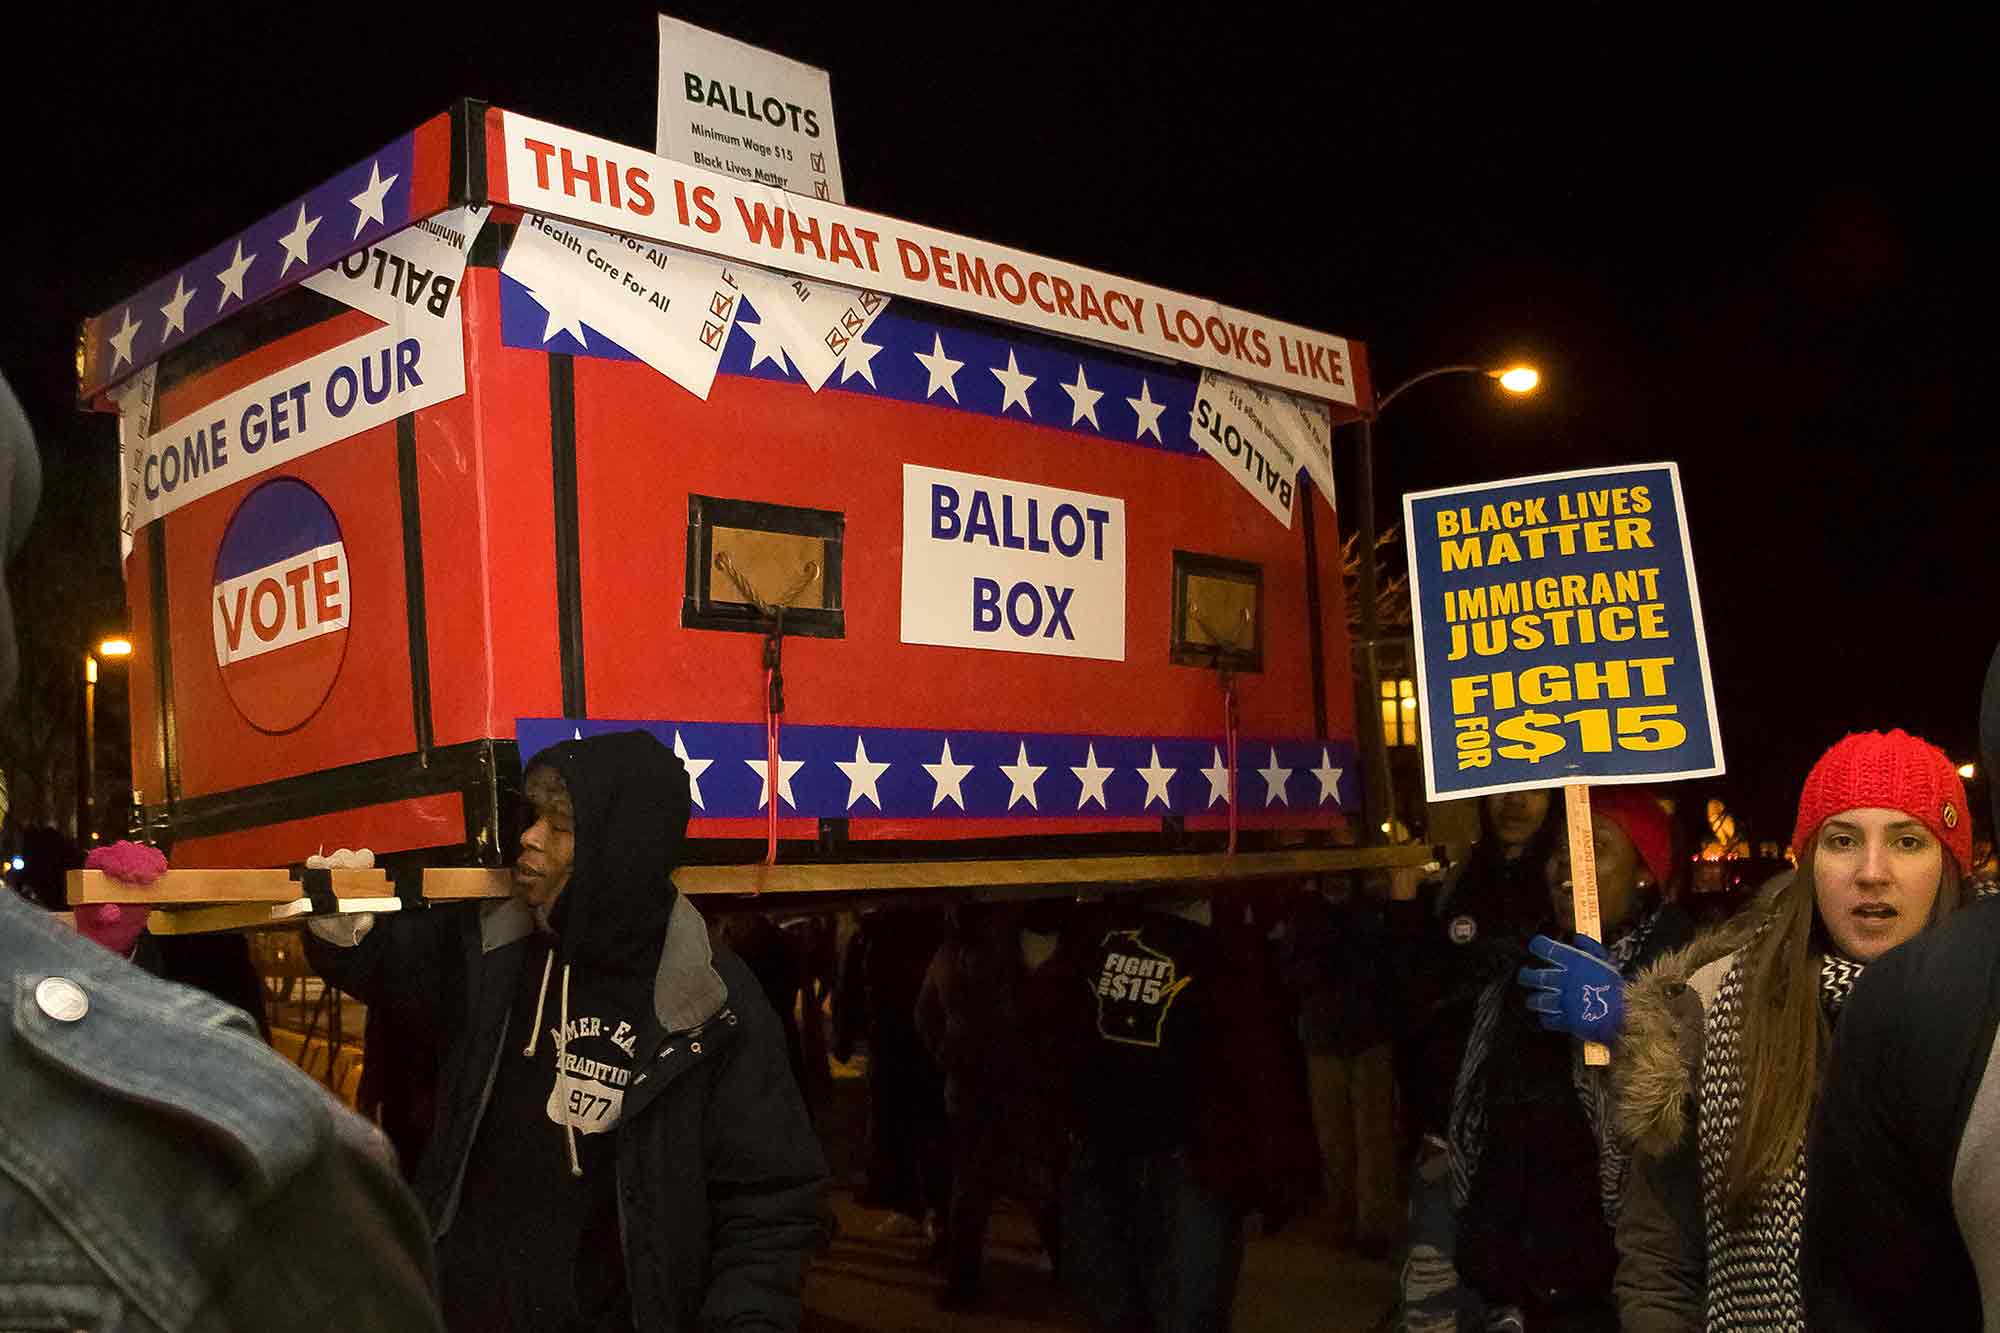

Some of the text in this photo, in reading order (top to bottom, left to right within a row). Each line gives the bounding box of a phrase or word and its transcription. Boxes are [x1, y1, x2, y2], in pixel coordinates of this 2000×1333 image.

[683, 71, 821, 139] BALLOTS
[691, 122, 794, 162] Minimum Wage $15
[693, 151, 789, 188] Black Lives Matter
[327, 247, 456, 319] BALLO
[524, 136, 1347, 386] THIS IS WHAT DEMOCRACY LOOKS LIKE
[530, 213, 671, 314] Health Care For All
[646, 248, 669, 270] All
[791, 279, 811, 303] All
[142, 337, 425, 502] COME GET OUR
[1196, 398, 1294, 513] BALLOTS
[931, 483, 1110, 560] BALLOT
[1436, 485, 1653, 539] BLACK LIVES
[1440, 517, 1656, 573] MATTER
[217, 555, 343, 652] VOTE
[973, 577, 1076, 640] BOX
[1444, 567, 1661, 624] IMMIGRANT
[1447, 603, 1670, 662] JUSTICE
[1450, 656, 1676, 715] FIGHT
[1454, 715, 1493, 771] FOR
[1494, 704, 1688, 765] $15
[1104, 952, 1169, 980] FIGHT
[1109, 973, 1162, 1005] $15
[555, 1051, 632, 1087] RADITIO
